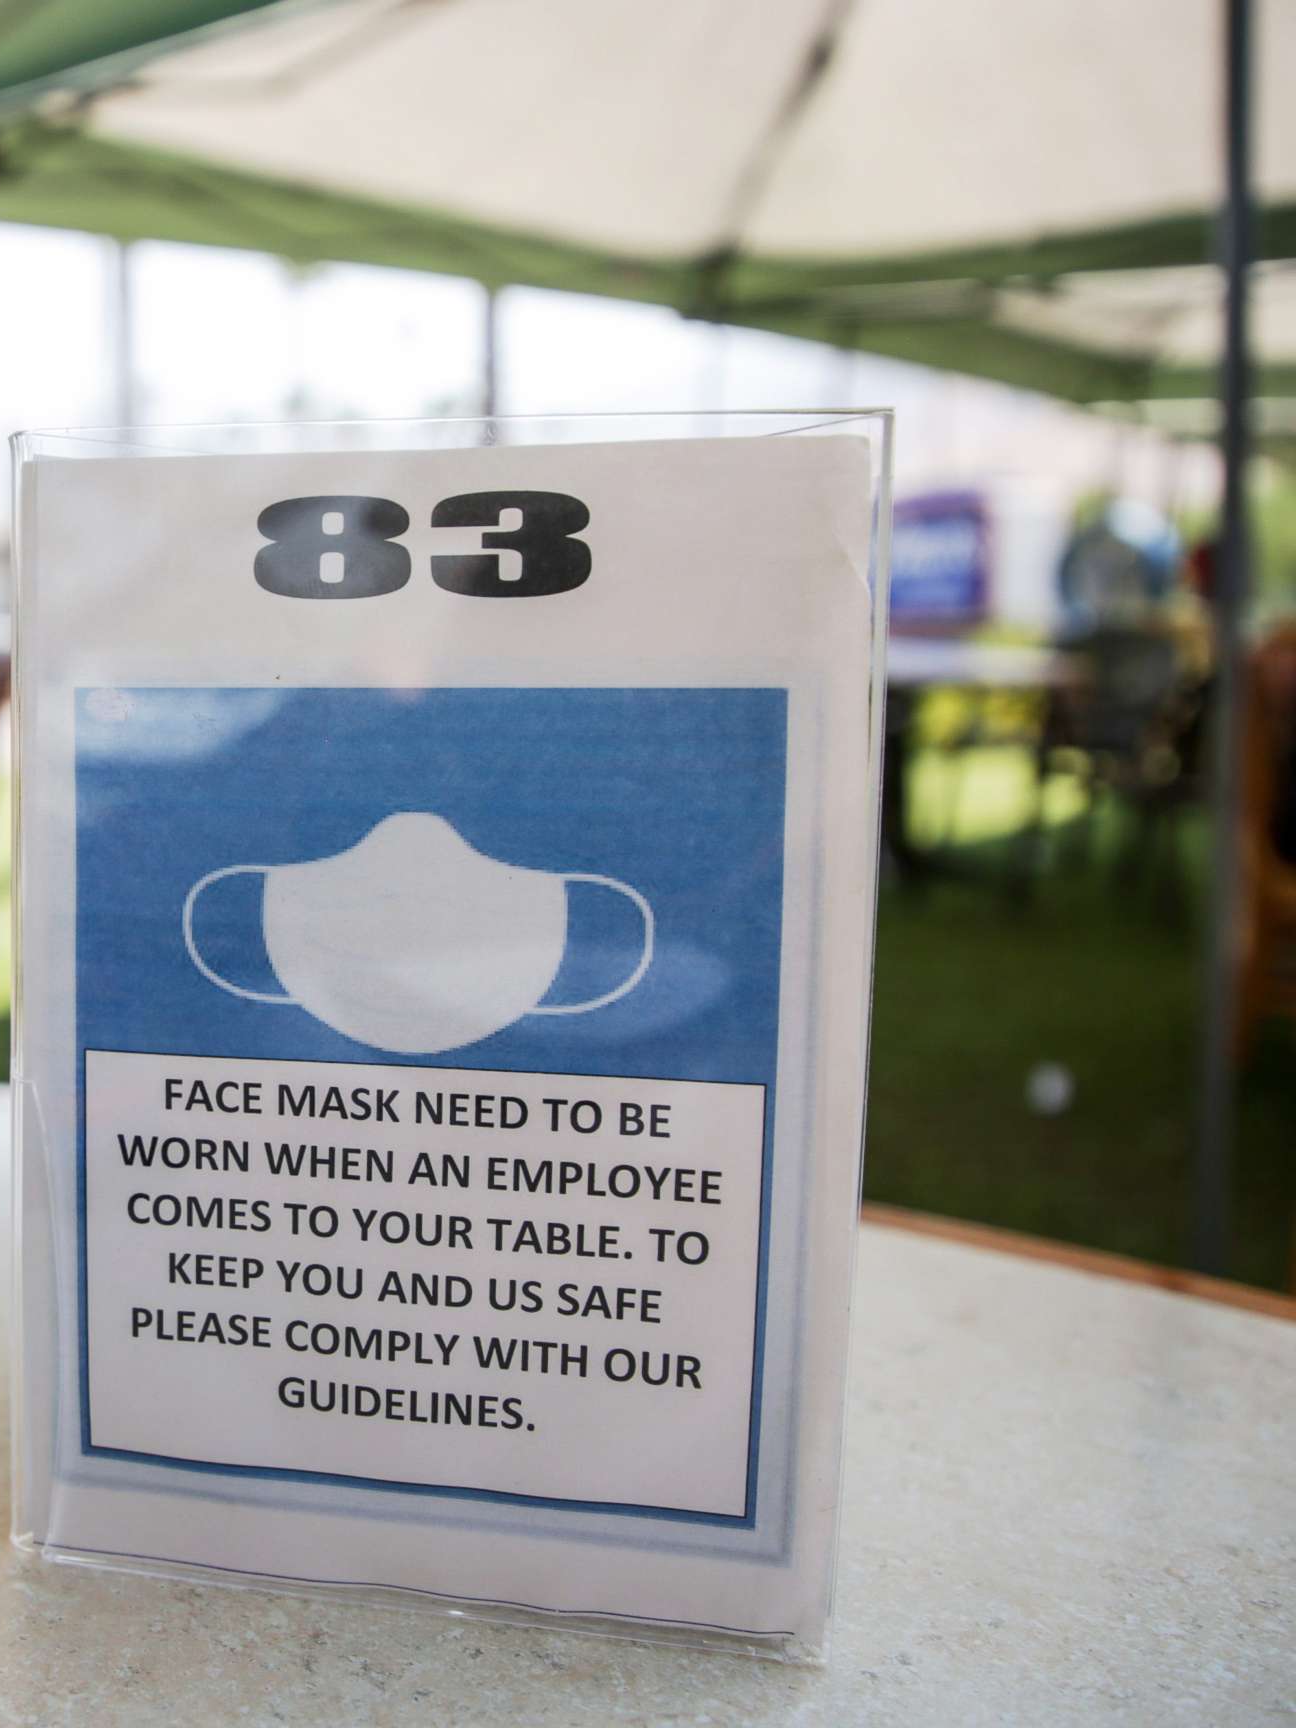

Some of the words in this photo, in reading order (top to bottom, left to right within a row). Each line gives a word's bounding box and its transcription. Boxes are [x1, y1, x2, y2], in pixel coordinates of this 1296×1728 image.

[253, 490, 592, 599] 83
[165, 1078, 263, 1115] FACE
[277, 1083, 400, 1123] MASK
[415, 1091, 529, 1130] NEED
[542, 1097, 603, 1134] TO
[619, 1102, 672, 1139] BE
[116, 1133, 249, 1173] WORN
[263, 1141, 394, 1183] WHEN
[407, 1151, 470, 1189] AN
[487, 1156, 723, 1205] EMPLOYEE
[127, 1192, 272, 1233] COMES
[283, 1202, 339, 1239] TO
[351, 1208, 474, 1250] YOUR
[486, 1218, 633, 1260] TABLE.
[648, 1228, 710, 1266] TO
[168, 1252, 265, 1289] KEEP
[275, 1259, 364, 1300] YOU
[377, 1270, 473, 1308] AND
[488, 1277, 544, 1314] US
[556, 1283, 662, 1324] SAFE
[131, 1306, 272, 1349] PLEASE
[284, 1319, 461, 1366] COMPLY
[472, 1335, 588, 1378] WITH
[603, 1347, 702, 1390] OUR
[277, 1376, 536, 1432] GUIDELINES.
